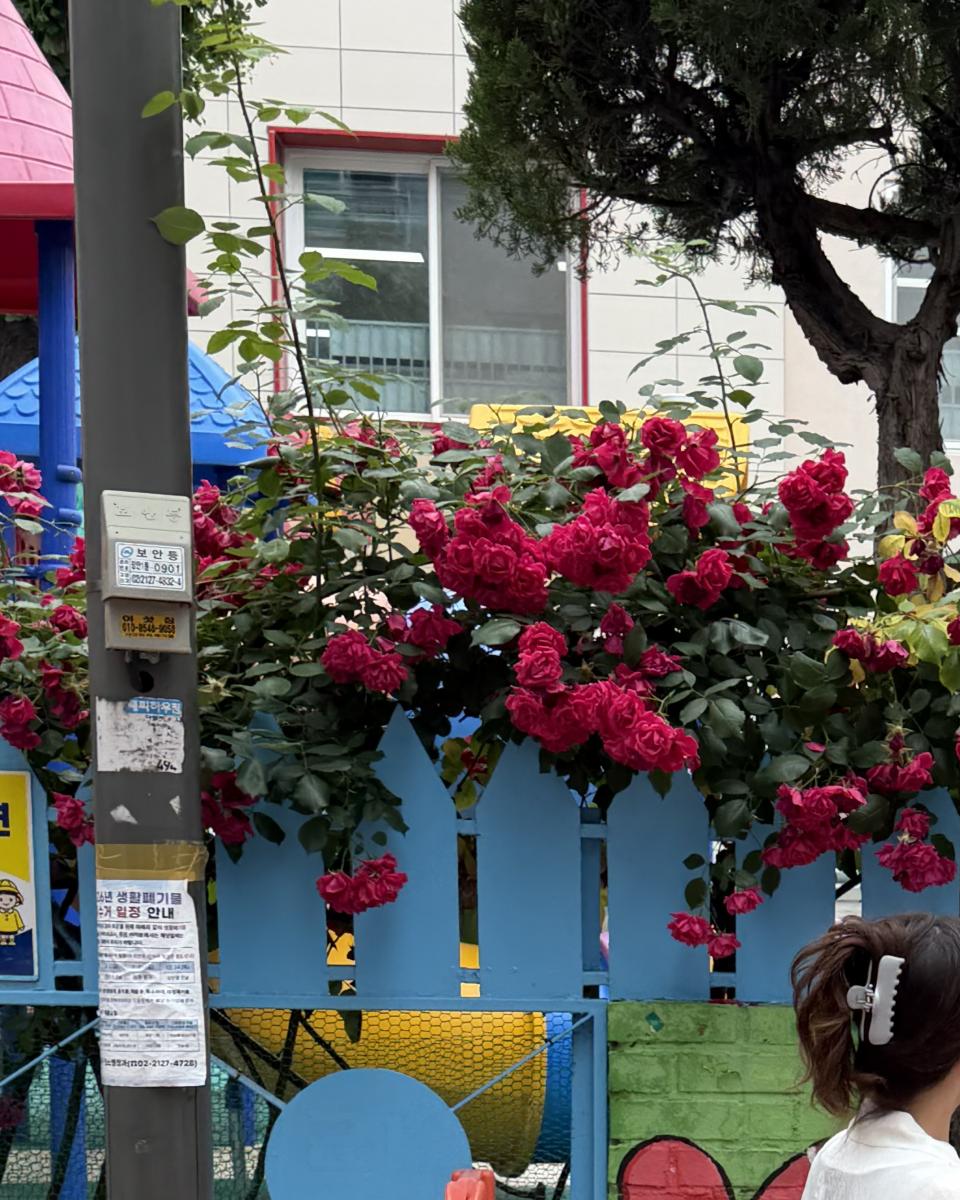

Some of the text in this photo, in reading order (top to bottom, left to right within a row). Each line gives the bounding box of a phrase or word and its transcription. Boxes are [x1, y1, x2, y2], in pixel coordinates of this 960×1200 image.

[136, 548, 178, 561] 보안등
[116, 905, 141, 919] 일정
[147, 906, 174, 919] 안내
